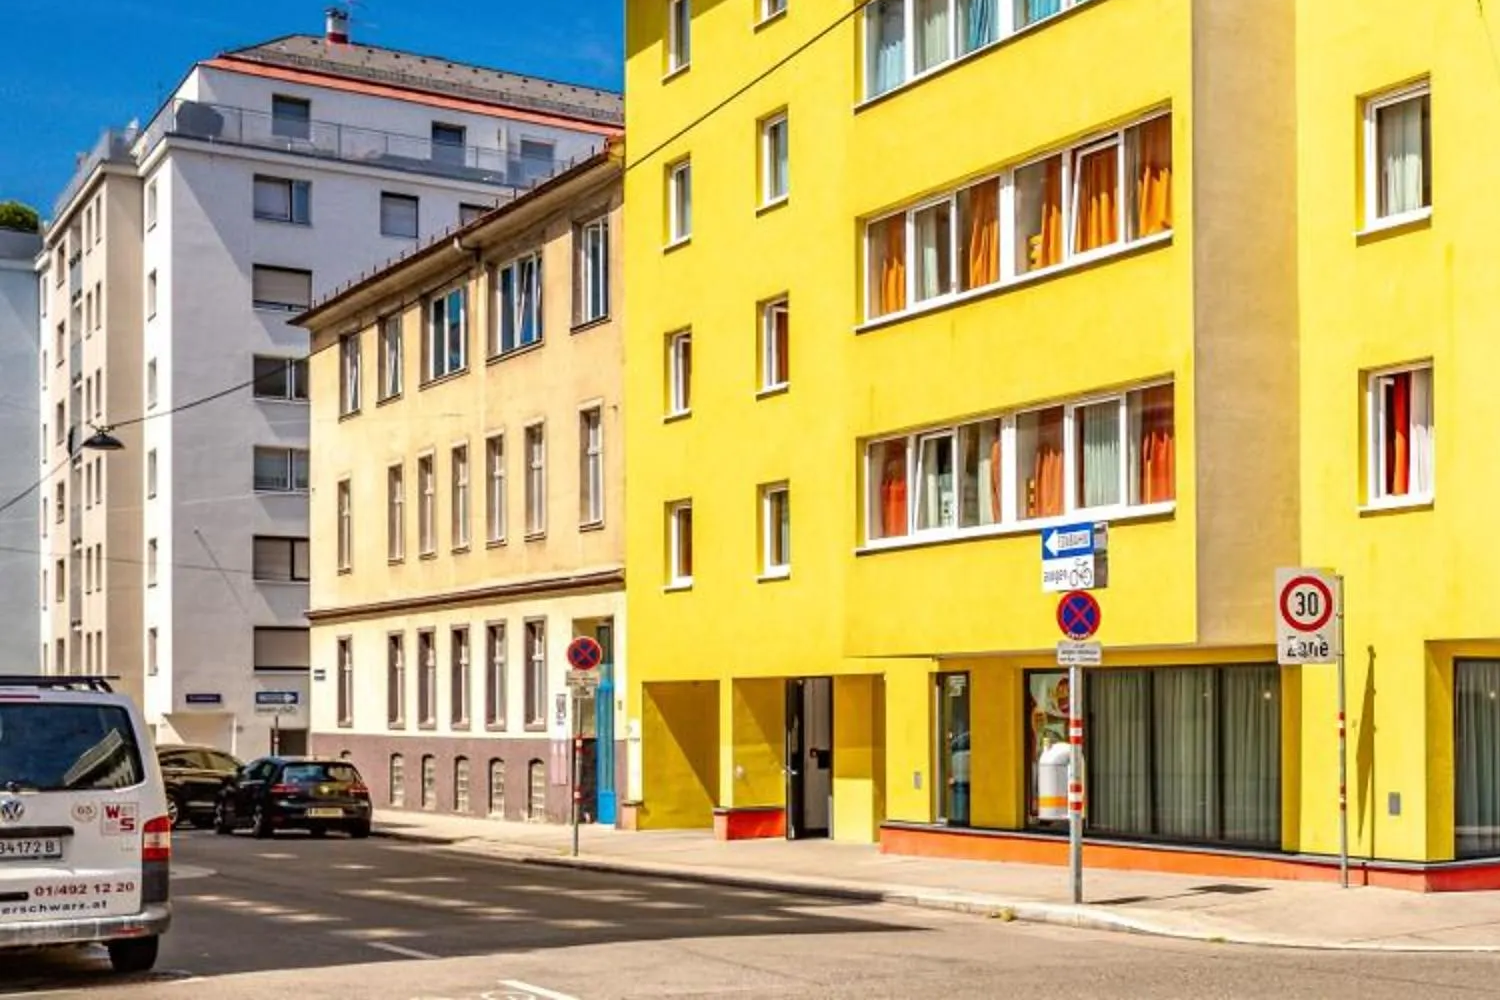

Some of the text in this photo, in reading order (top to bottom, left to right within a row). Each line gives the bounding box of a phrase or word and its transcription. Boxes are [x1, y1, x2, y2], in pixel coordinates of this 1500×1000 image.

[1295, 591, 1319, 617] 30
[34, 881, 135, 897] 01/492 12 20
